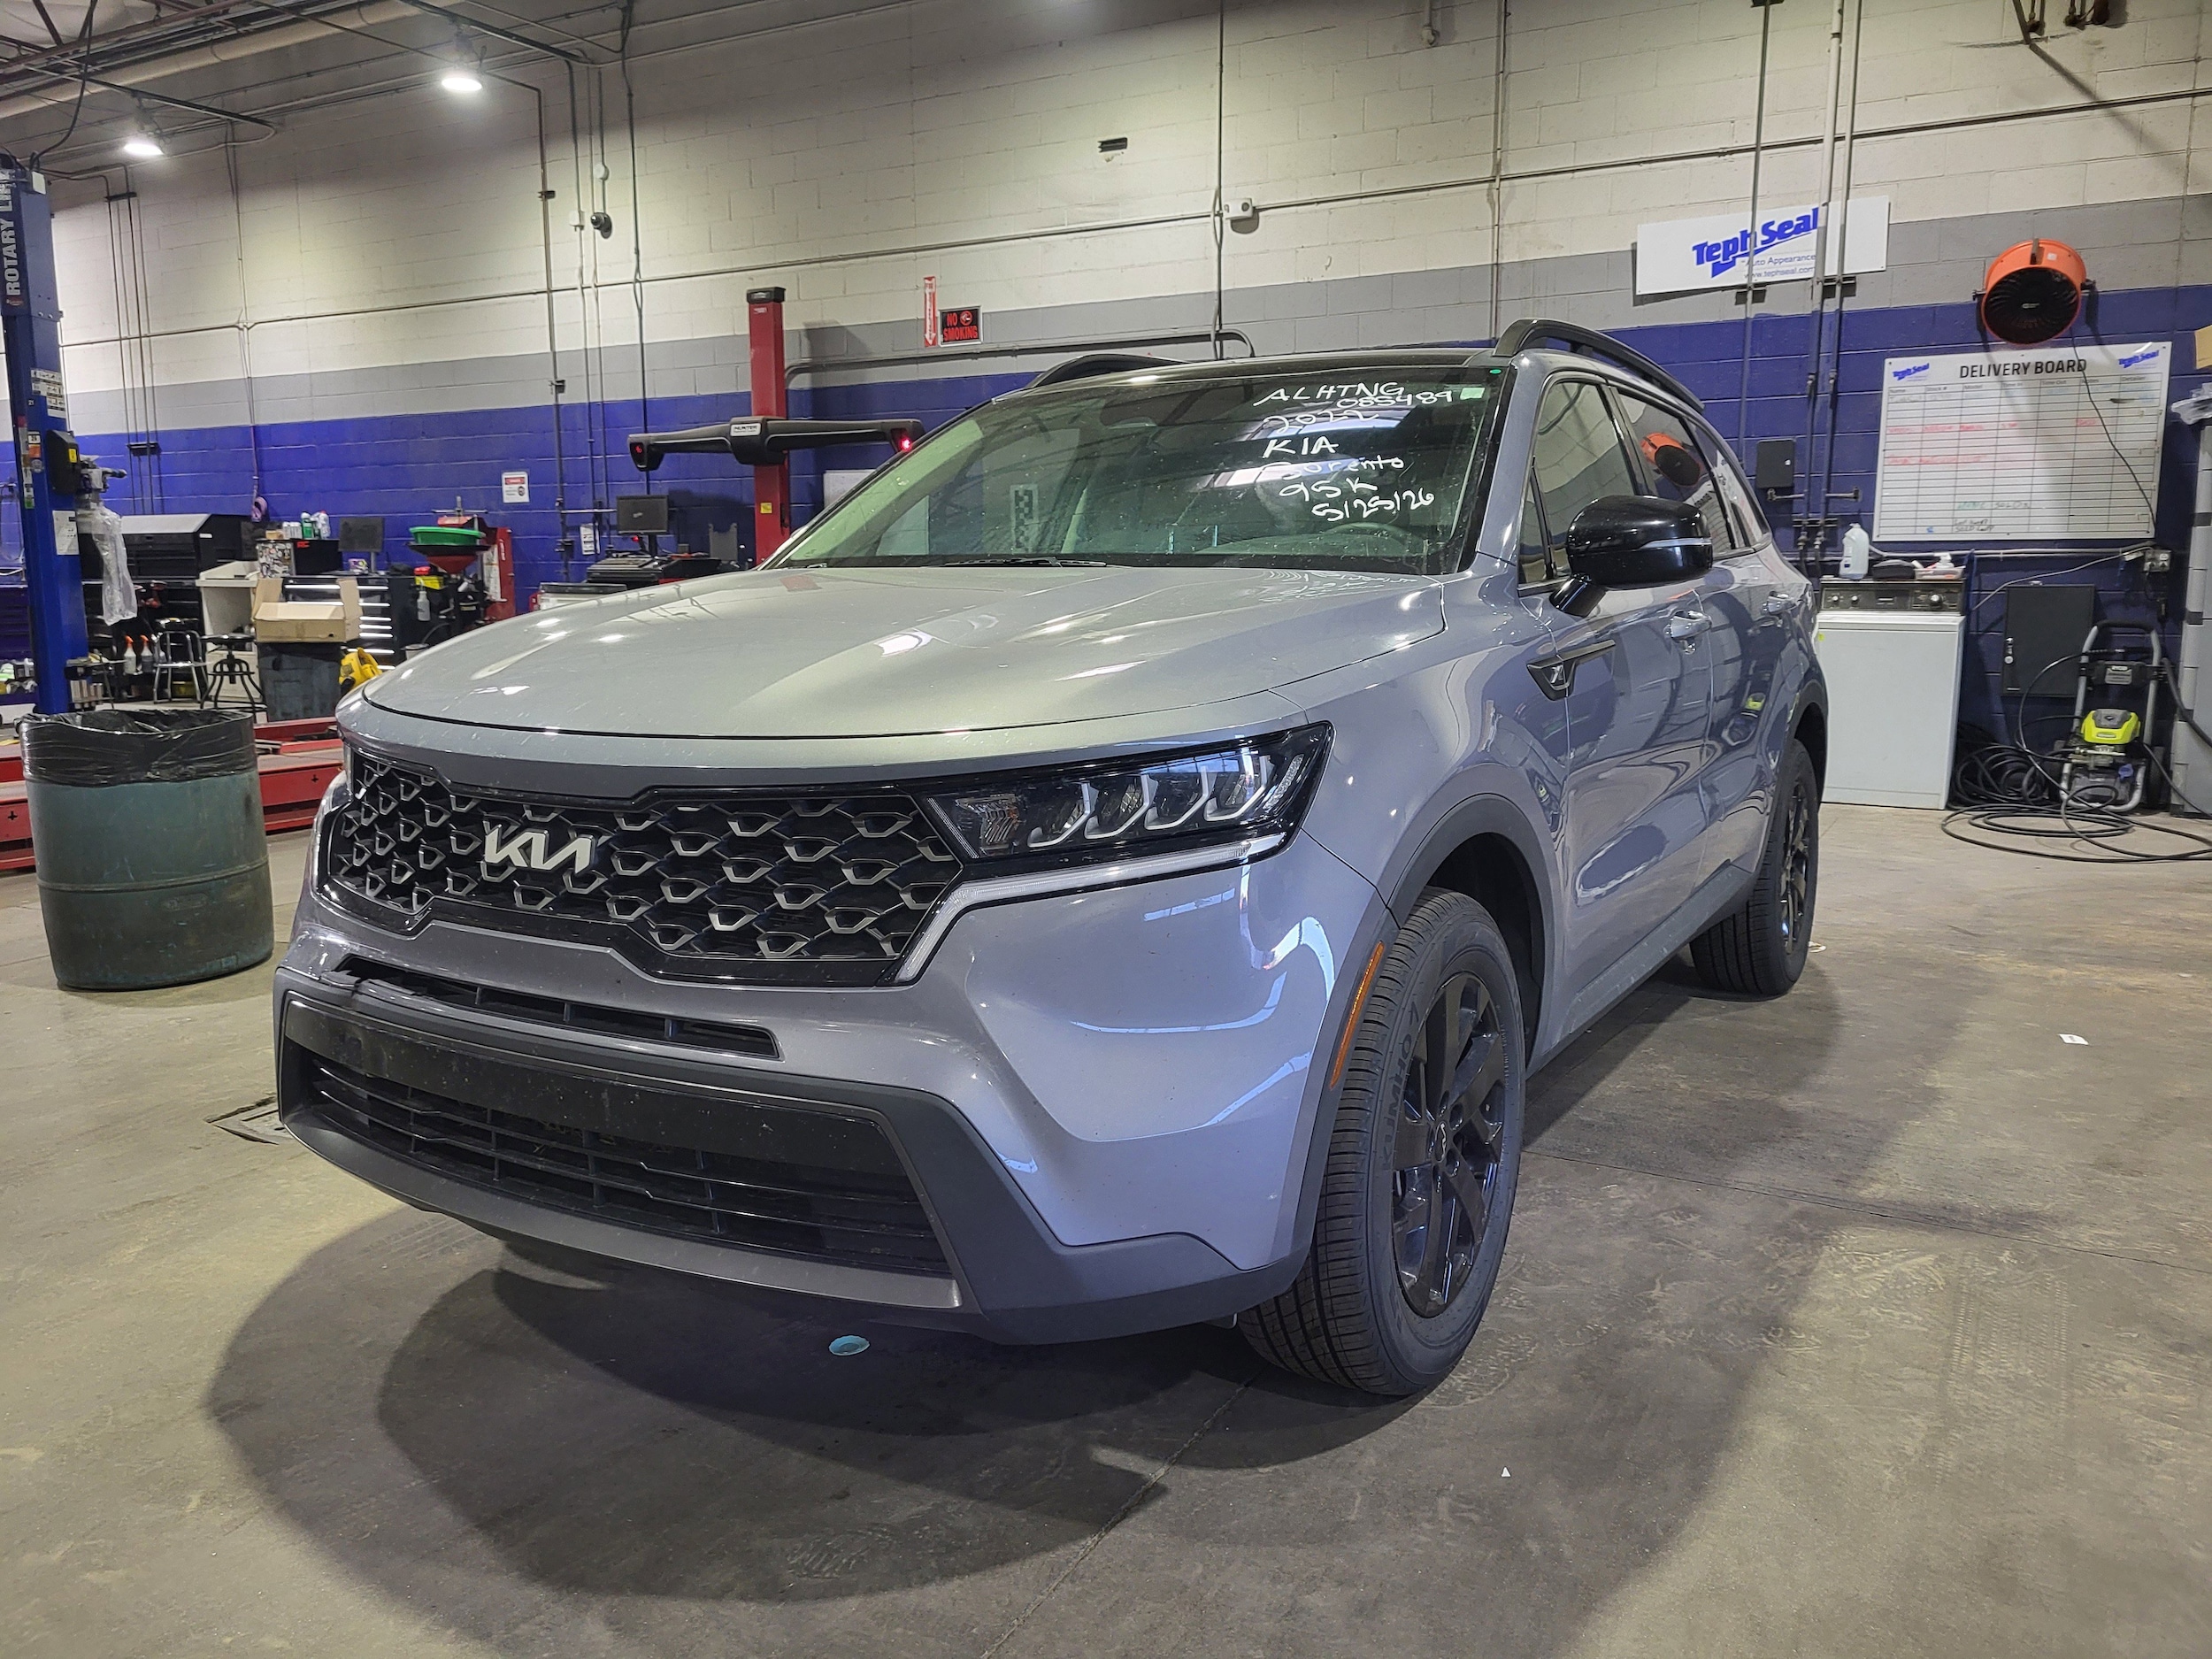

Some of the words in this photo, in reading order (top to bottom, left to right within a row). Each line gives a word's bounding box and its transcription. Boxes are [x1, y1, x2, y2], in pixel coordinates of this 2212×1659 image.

[1692, 228, 1757, 272] Teph
[1761, 207, 1819, 245] Seal
[0, 219, 20, 296] ROTARY
[1768, 254, 1816, 265] Appearance
[946, 312, 958, 326] NO
[943, 326, 978, 341] SMOKING
[1959, 362, 2031, 379] DELIVERY
[2034, 358, 2087, 375] BOARD
[1263, 410, 1379, 434] 2022
[1263, 436, 1340, 458] KIA
[484, 824, 596, 874] KIA
